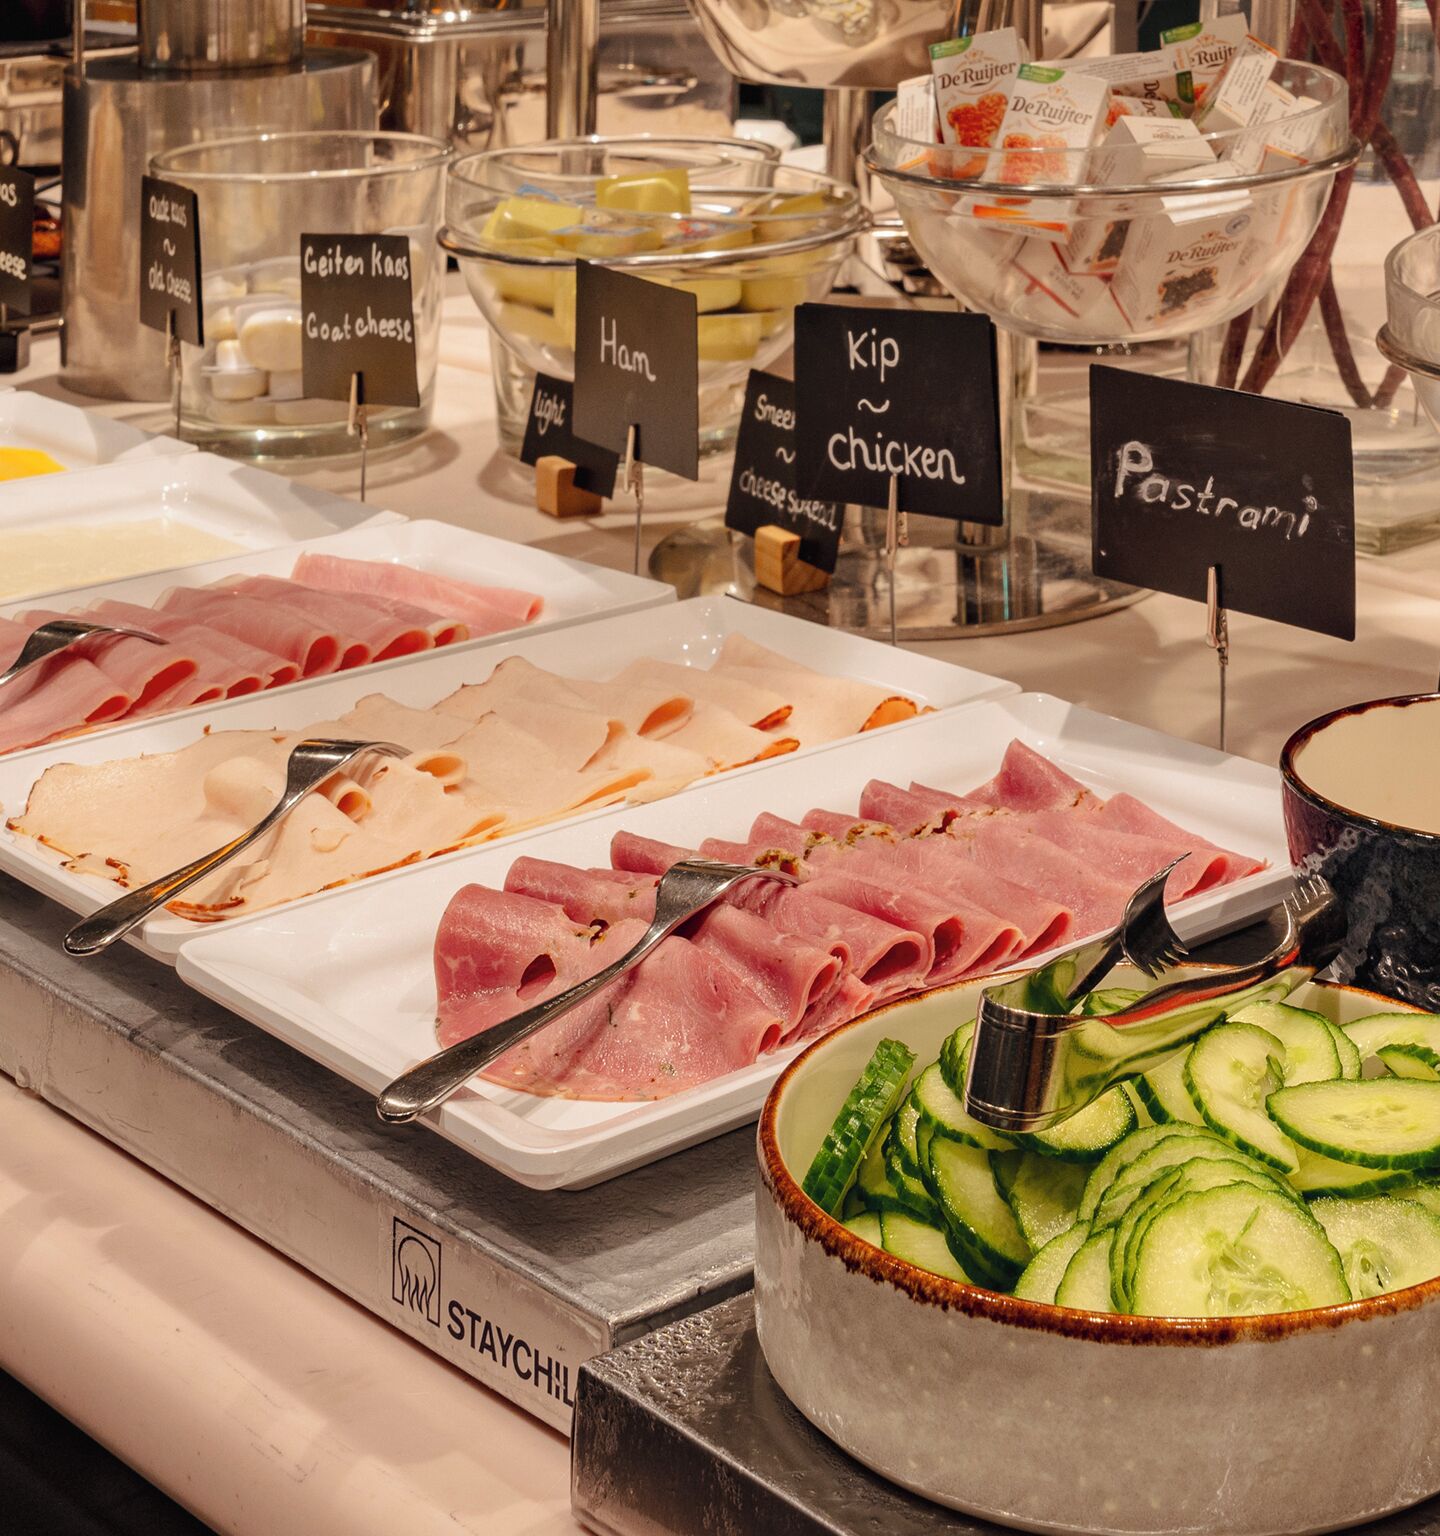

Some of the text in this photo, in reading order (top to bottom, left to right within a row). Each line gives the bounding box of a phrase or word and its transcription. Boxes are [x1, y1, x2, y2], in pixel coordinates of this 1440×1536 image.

[1198, 46, 1237, 65] Ruijt
[938, 73, 960, 89] De
[962, 62, 1016, 84] Ruijter
[1011, 96, 1093, 125] De Ruijter
[0, 184, 17, 207] as
[304, 244, 364, 277] Geiten
[306, 305, 413, 343] Goat cheese
[600, 318, 656, 382] Ham
[847, 327, 900, 383] Kip
[1113, 440, 1319, 540] Pastrami
[446, 1299, 574, 1408] STAYCHIL
